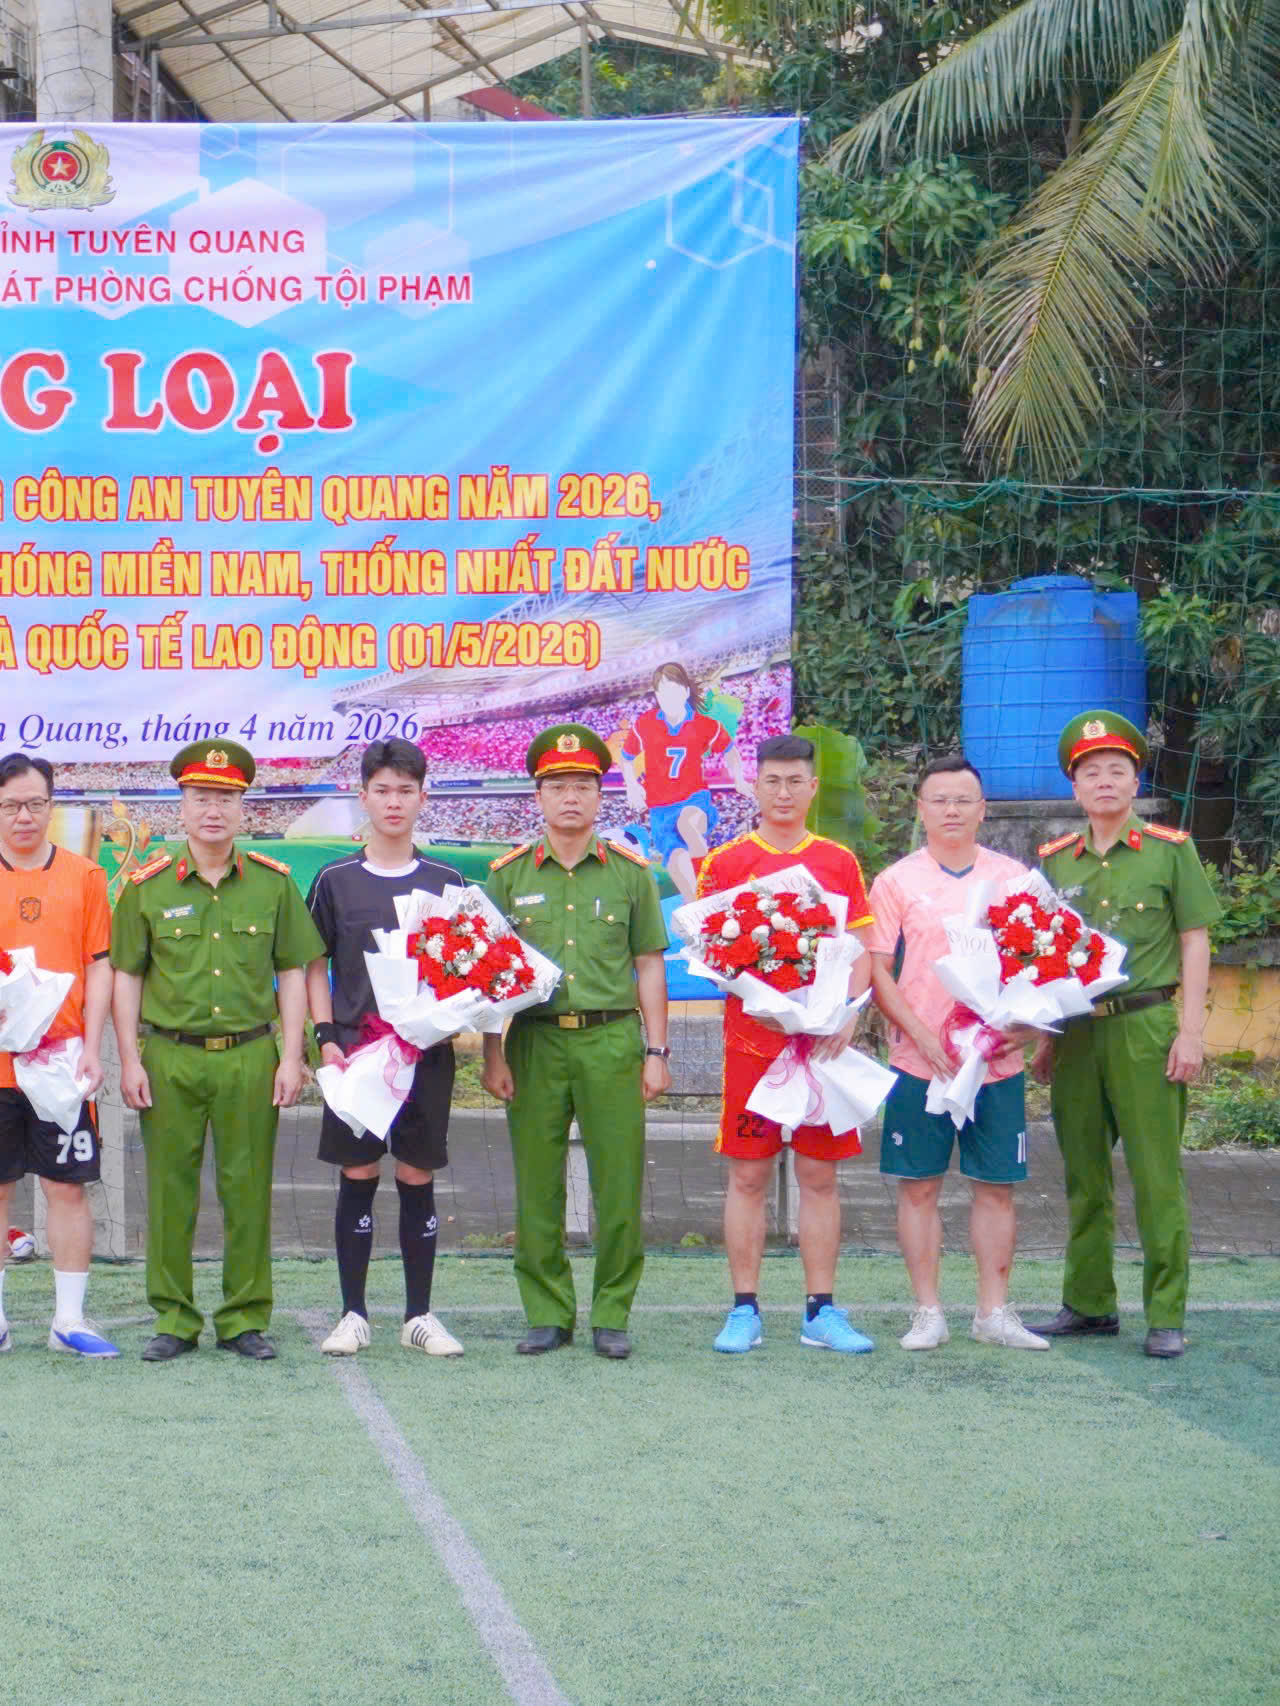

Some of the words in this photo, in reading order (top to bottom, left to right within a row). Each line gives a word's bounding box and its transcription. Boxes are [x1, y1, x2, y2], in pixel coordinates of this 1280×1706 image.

[69, 223, 178, 256] TUYÊN
[189, 230, 306, 256] QUANG
[56, 269, 172, 304] PHÒNG
[184, 264, 303, 304] CHỐNG
[315, 267, 367, 308] TỘI
[380, 276, 472, 307] PHẠM
[104, 351, 356, 455] LOẠI
[14, 468, 120, 522] CÔNG
[128, 474, 184, 522] AN
[192, 467, 314, 522] TUYÊN
[322, 473, 450, 526] QUANG
[458, 464, 550, 522] NĂM
[557, 473, 663, 523] 2026,
[102, 537, 204, 598] MIỀN
[211, 549, 314, 602] NAM,
[322, 536, 448, 597] THỐNG
[456, 532, 558, 595] NHẤT
[564, 532, 641, 594] ĐẤT
[646, 536, 752, 592] NƯỚC
[26, 608, 130, 675] QUỐC
[138, 608, 185, 671] TẾ
[194, 622, 264, 671] LAO
[271, 614, 378, 680] ĐỘNG
[388, 622, 603, 674] (01/5/2026)
[19, 713, 129, 750] Quang,
[239, 713, 258, 741] 4
[267, 713, 335, 741] năm
[344, 712, 419, 741] 2026
[666, 747, 687, 779] 7
[736, 1113, 766, 1138] 22
[56, 1130, 94, 1164] 79
